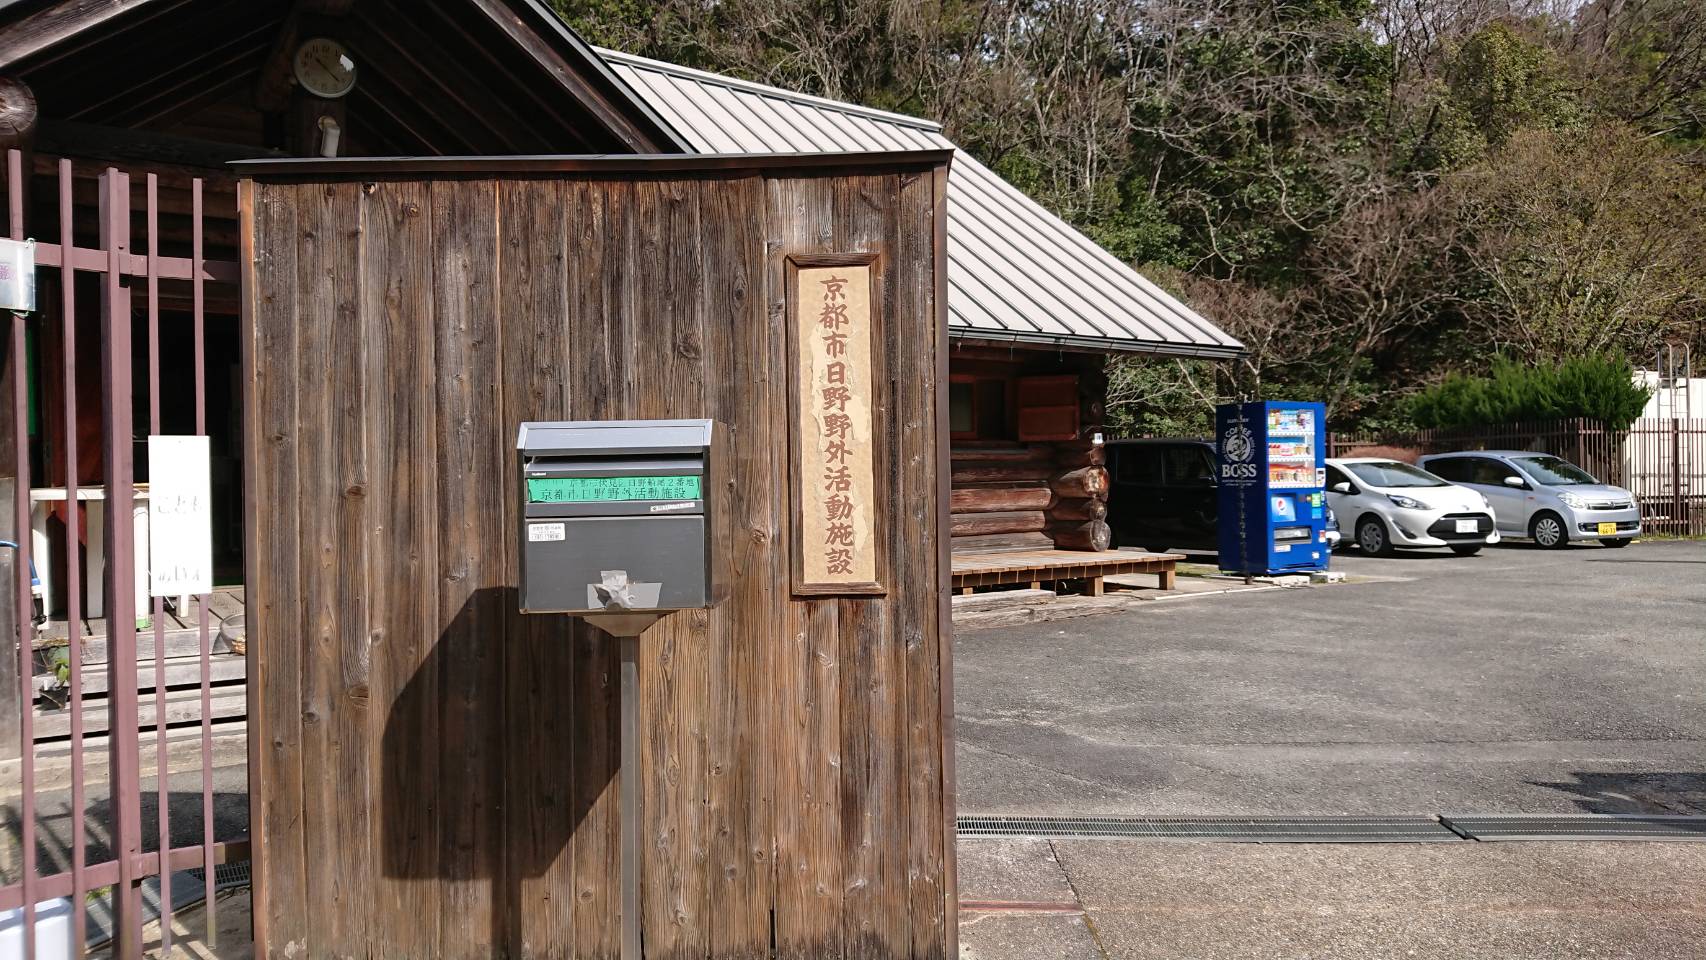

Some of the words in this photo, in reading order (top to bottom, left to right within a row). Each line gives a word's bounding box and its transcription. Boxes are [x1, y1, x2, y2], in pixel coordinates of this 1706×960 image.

[819, 275, 854, 575] 京都市日野野外活動施設
[1221, 464, 1257, 477] BOSS
